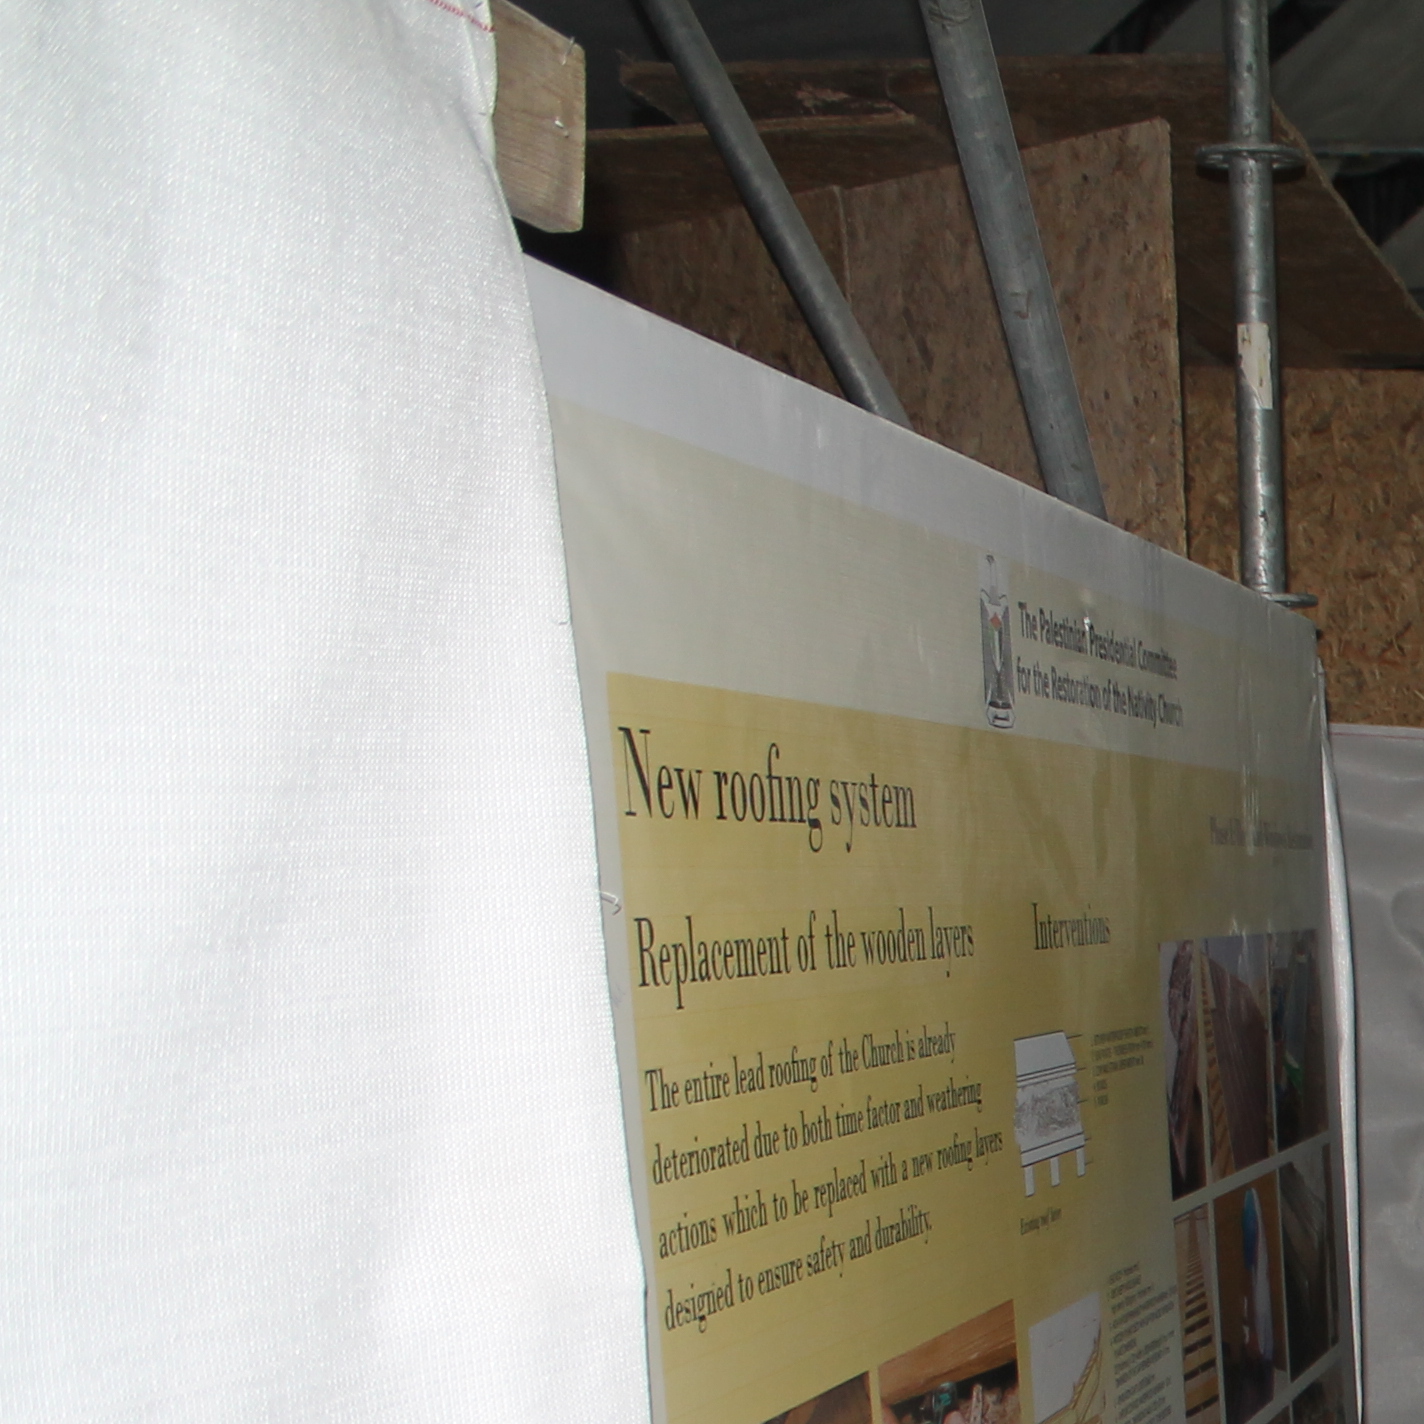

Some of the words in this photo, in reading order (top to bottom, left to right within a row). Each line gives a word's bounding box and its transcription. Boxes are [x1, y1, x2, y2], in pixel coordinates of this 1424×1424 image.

[1016, 655, 1032, 695] for
[1032, 661, 1050, 699] the
[1050, 665, 1102, 709] Restoration
[1101, 678, 1112, 712] of
[1017, 601, 1038, 641] The
[1038, 607, 1089, 654] Palestinian
[1088, 621, 1136, 667] Presidential
[617, 727, 702, 819] New
[714, 742, 823, 853] roofing
[829, 773, 917, 852] system
[633, 914, 791, 1010] Replacement
[798, 909, 818, 971] of
[825, 908, 857, 969] the
[861, 906, 927, 965] wooden
[929, 906, 975, 978] layers
[1031, 902, 1111, 952] Interventions
[644, 1068, 680, 1112] The
[684, 1062, 730, 1105] entire
[732, 1051, 766, 1096] lead
[768, 1045, 818, 1093] roofing
[819, 1039, 834, 1078] of
[837, 1037, 859, 1075] the
[861, 1029, 905, 1070] Church
[905, 1029, 916, 1062] is
[917, 1021, 956, 1064] already
[652, 1123, 750, 1185] deteriorated
[753, 1120, 780, 1159] due
[782, 1123, 799, 1152] to
[799, 1105, 833, 1147] both
[834, 1103, 864, 1138] time
[866, 1095, 901, 1130] factor
[903, 1083, 925, 1121] and
[926, 1075, 983, 1113] weathering
[658, 1212, 717, 1260] actions
[722, 1189, 769, 1236] which
[772, 1193, 789, 1223] to
[791, 1178, 809, 1217] be
[813, 1159, 867, 1218] replaced
[870, 1151, 898, 1189] with
[901, 1159, 909, 1182] a
[911, 1152, 934, 1178] new
[936, 1132, 974, 1172] roofing
[974, 1126, 1003, 1166] layers
[664, 1268, 735, 1334] designed
[737, 1273, 755, 1303] to
[757, 1258, 803, 1296] ensure
[806, 1234, 845, 1278] safety
[849, 1219, 873, 1261] and
[874, 1204, 932, 1251] durability.
